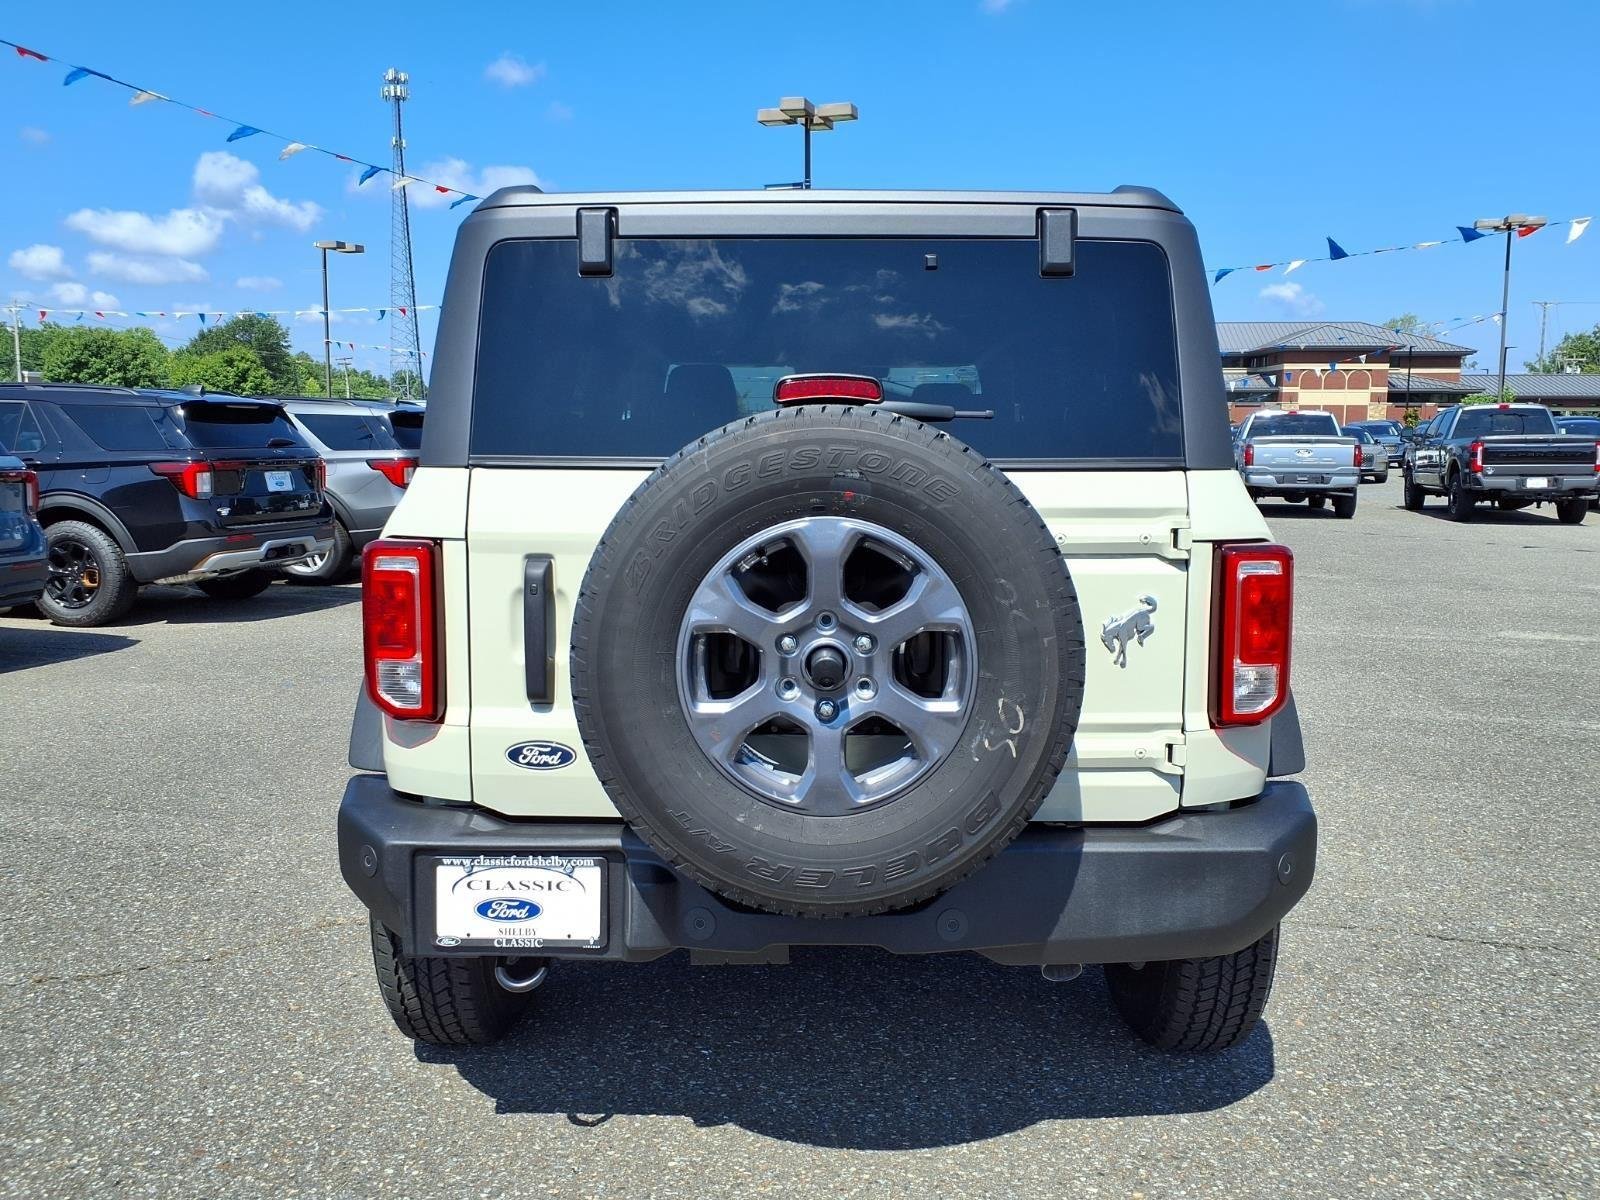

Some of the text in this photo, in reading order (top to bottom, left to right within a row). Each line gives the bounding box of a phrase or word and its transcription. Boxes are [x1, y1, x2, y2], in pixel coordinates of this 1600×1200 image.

[623, 445, 960, 595] BRIDGESTONE
[518, 745, 562, 765] Ford
[743, 788, 1006, 890] DUELER
[442, 855, 595, 868] www.classicfordshelby.com
[466, 879, 572, 892] CLASSIC
[487, 900, 529, 919] Ford
[498, 928, 537, 936] SHELBY
[494, 938, 544, 948] CLASSIC
